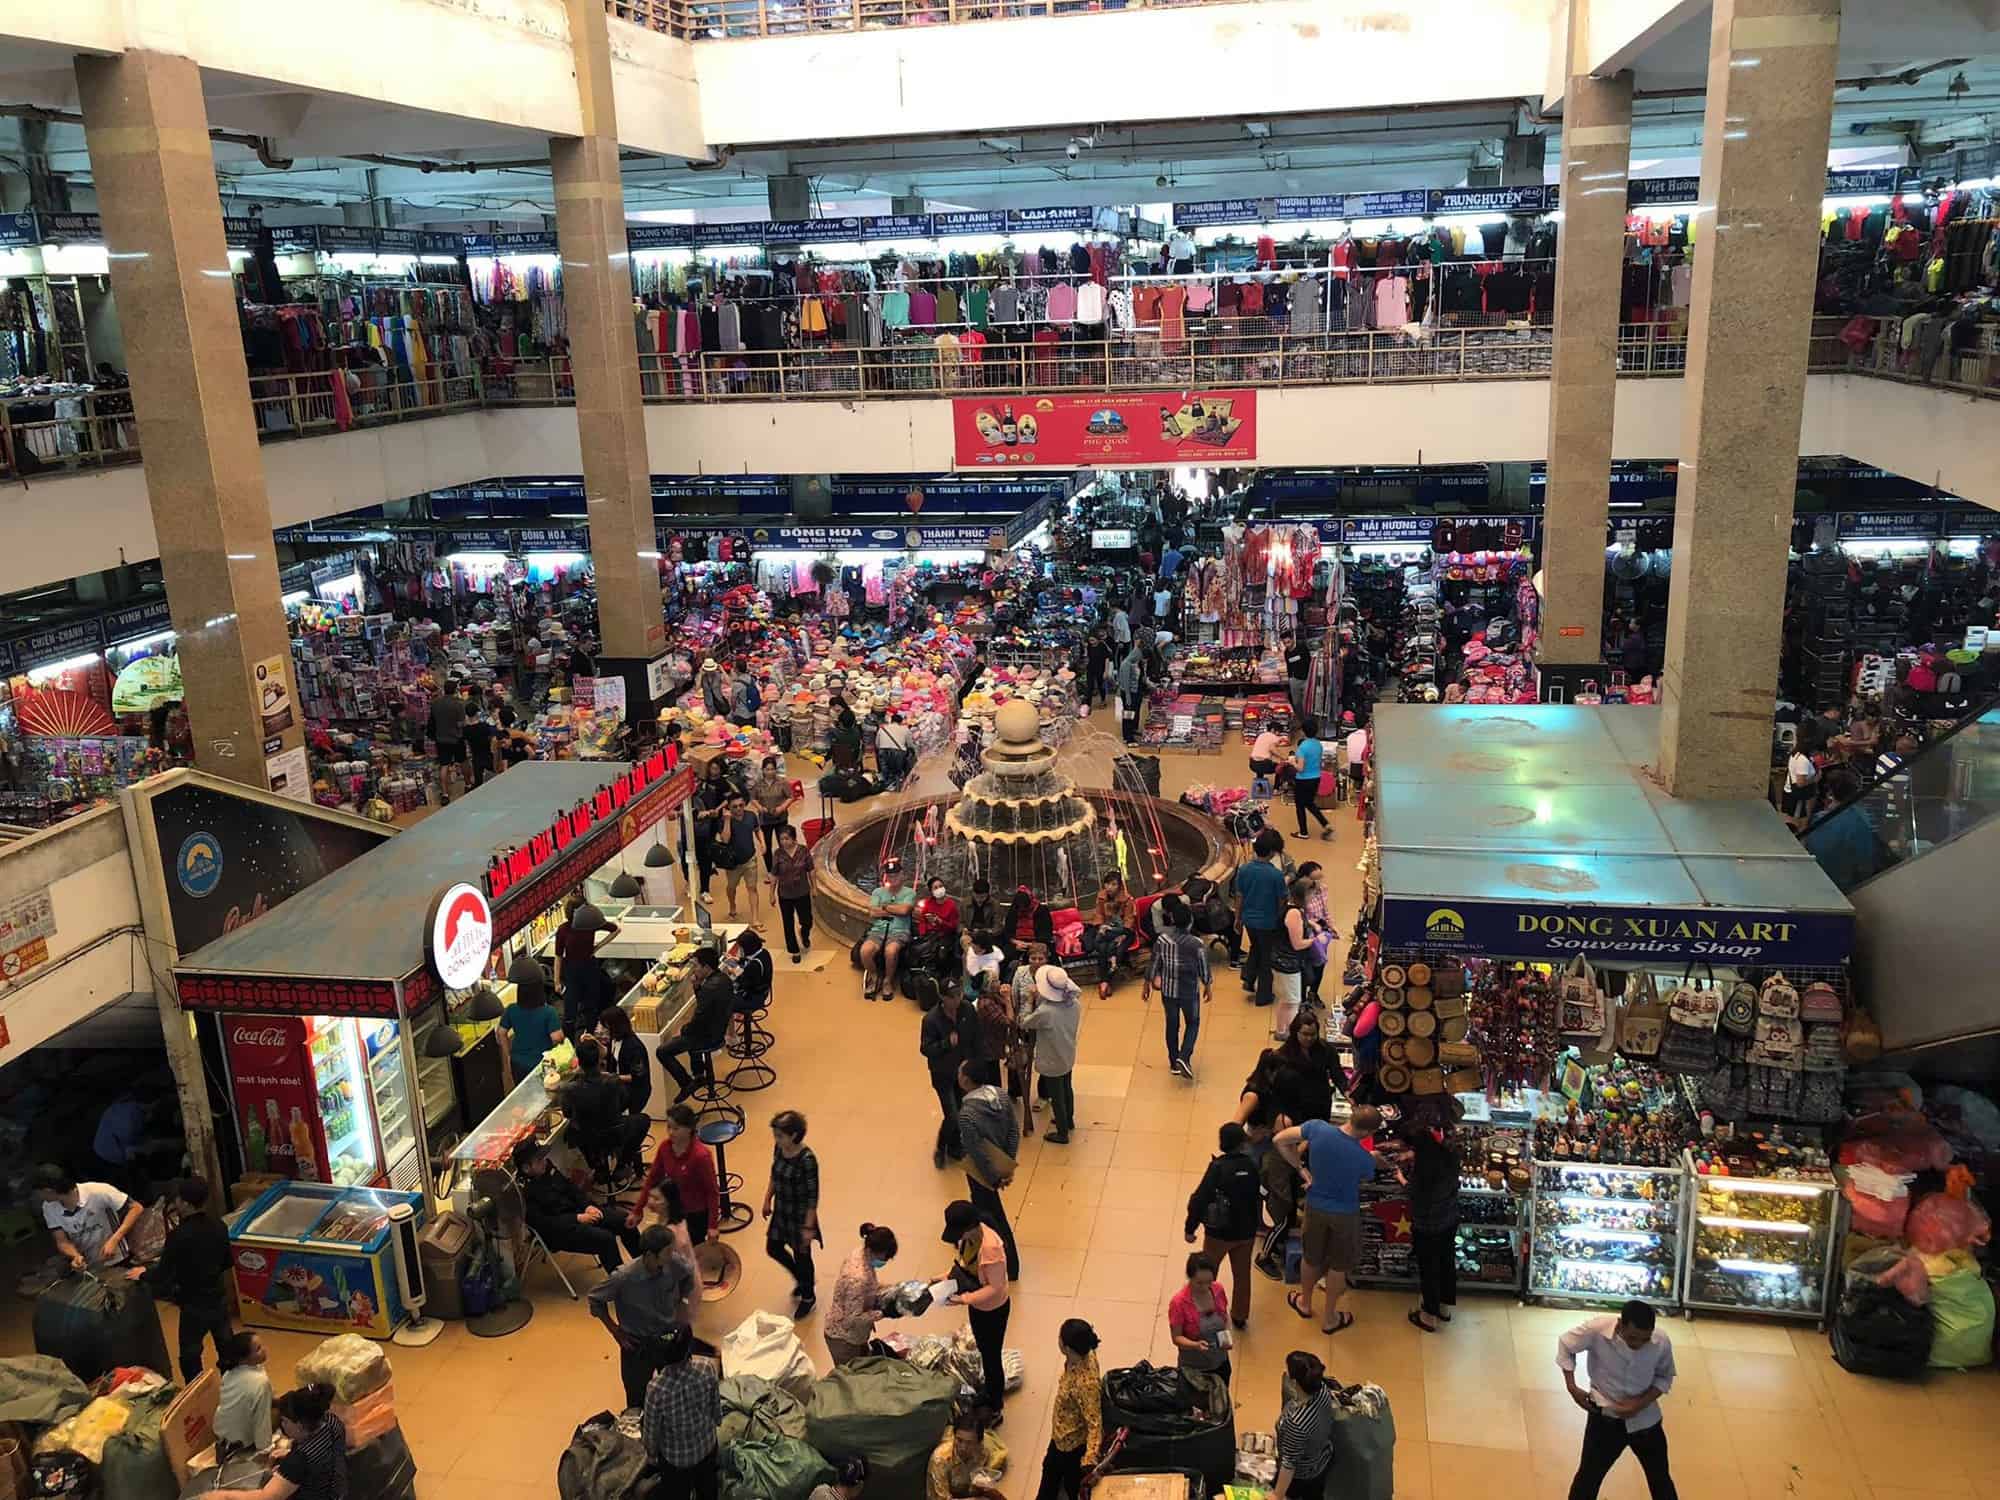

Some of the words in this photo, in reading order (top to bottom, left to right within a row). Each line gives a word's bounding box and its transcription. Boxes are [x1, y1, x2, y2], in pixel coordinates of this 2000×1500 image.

[947, 214, 966, 223] LAN
[969, 213, 989, 223] ANH
[829, 528, 863, 537] HOA
[1518, 914, 1614, 937] DONG
[1623, 917, 1720, 940] XUAN
[1725, 922, 1798, 943] ART
[1545, 935, 1683, 953] Souvenirs
[1689, 940, 1763, 959] Shop
